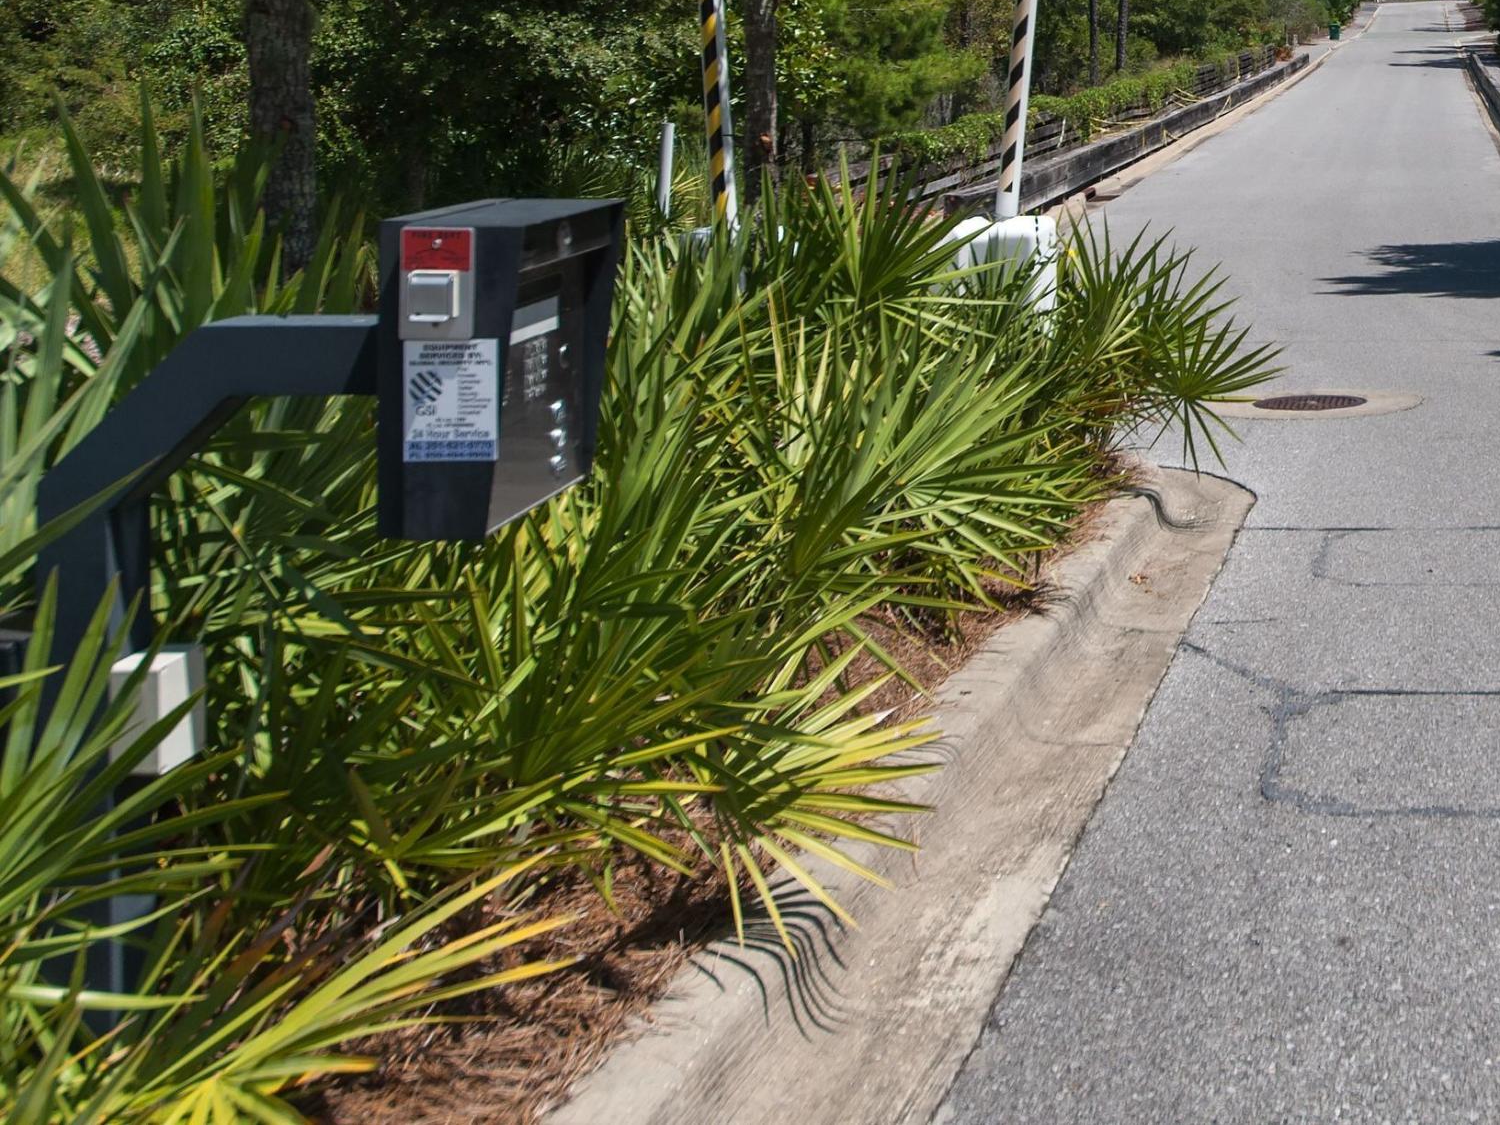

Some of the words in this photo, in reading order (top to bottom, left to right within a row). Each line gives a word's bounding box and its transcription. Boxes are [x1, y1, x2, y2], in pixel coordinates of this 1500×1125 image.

[419, 352, 465, 360] SERVICES
[415, 405, 435, 417] GSI
[412, 429, 424, 439] 24
[426, 429, 450, 438] Hour
[454, 429, 489, 438] Service
